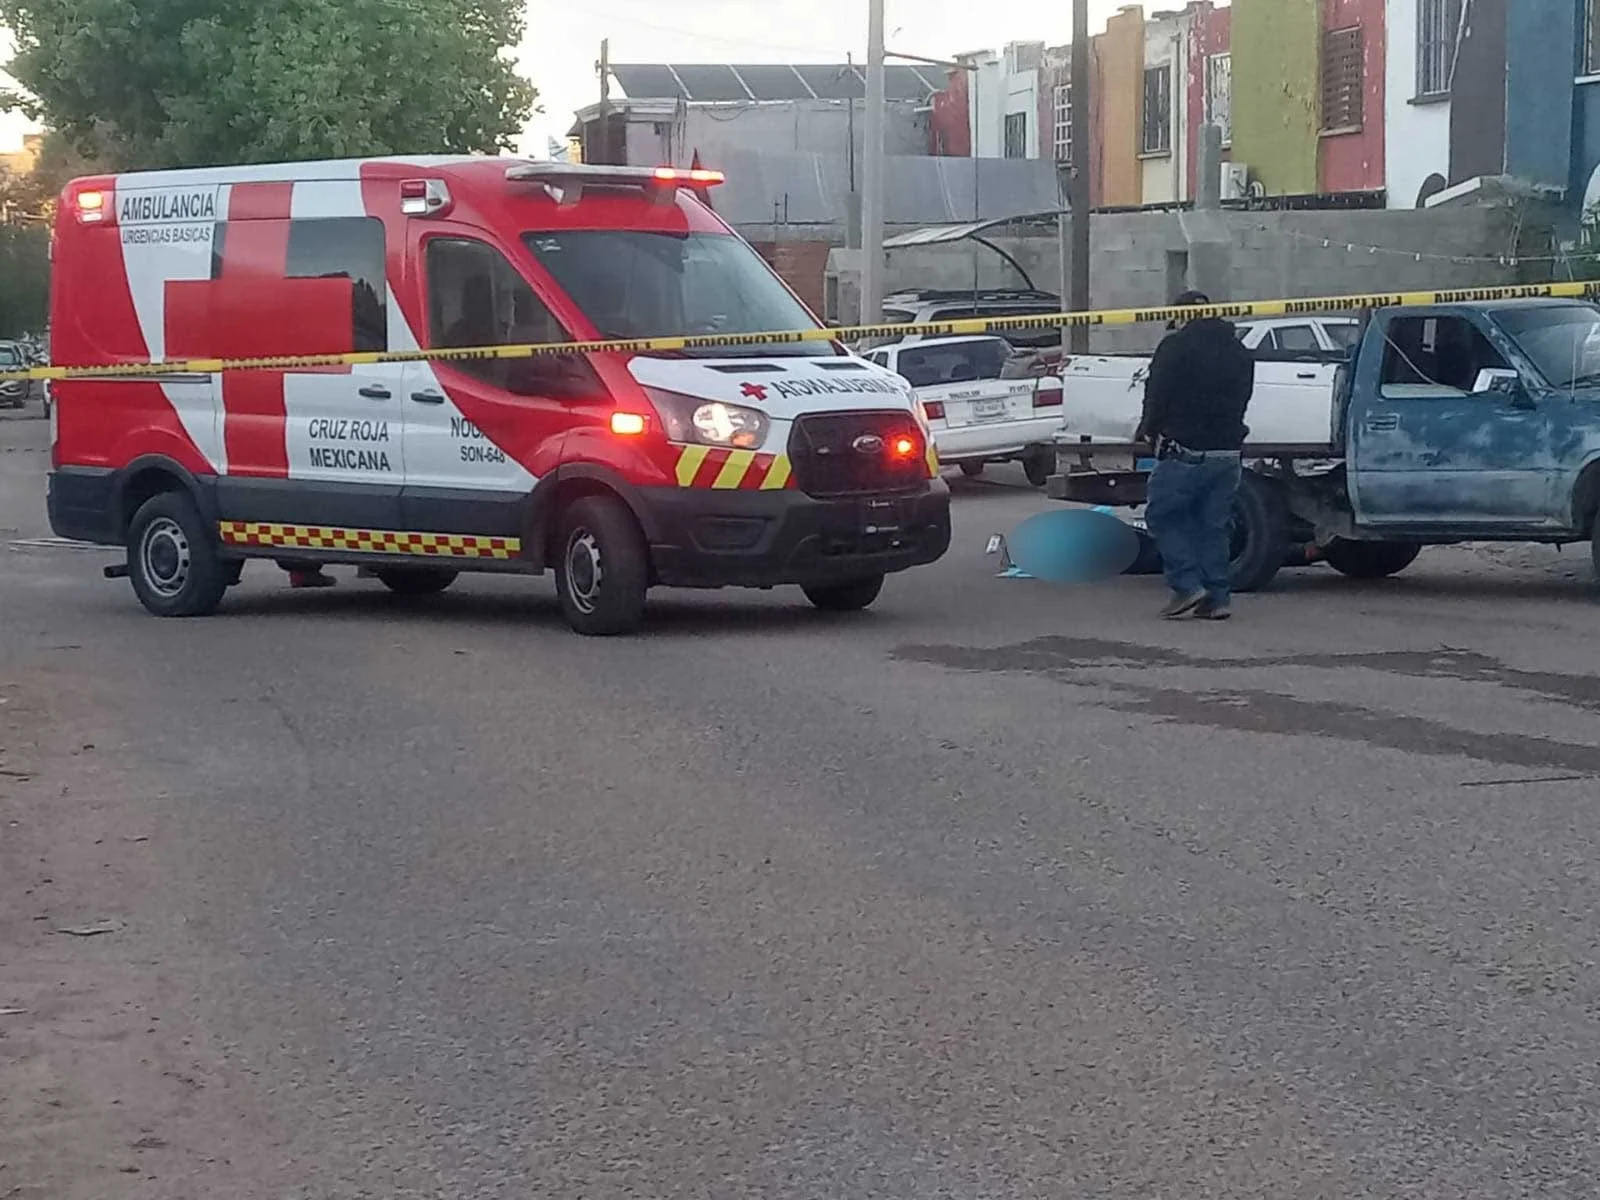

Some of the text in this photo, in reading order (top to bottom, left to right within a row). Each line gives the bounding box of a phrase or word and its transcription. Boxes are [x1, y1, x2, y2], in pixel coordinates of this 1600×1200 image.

[120, 193, 215, 221] AMBULANCIA
[309, 418, 389, 442] CRUZ ROJA
[309, 447, 392, 472] MEXICANA
